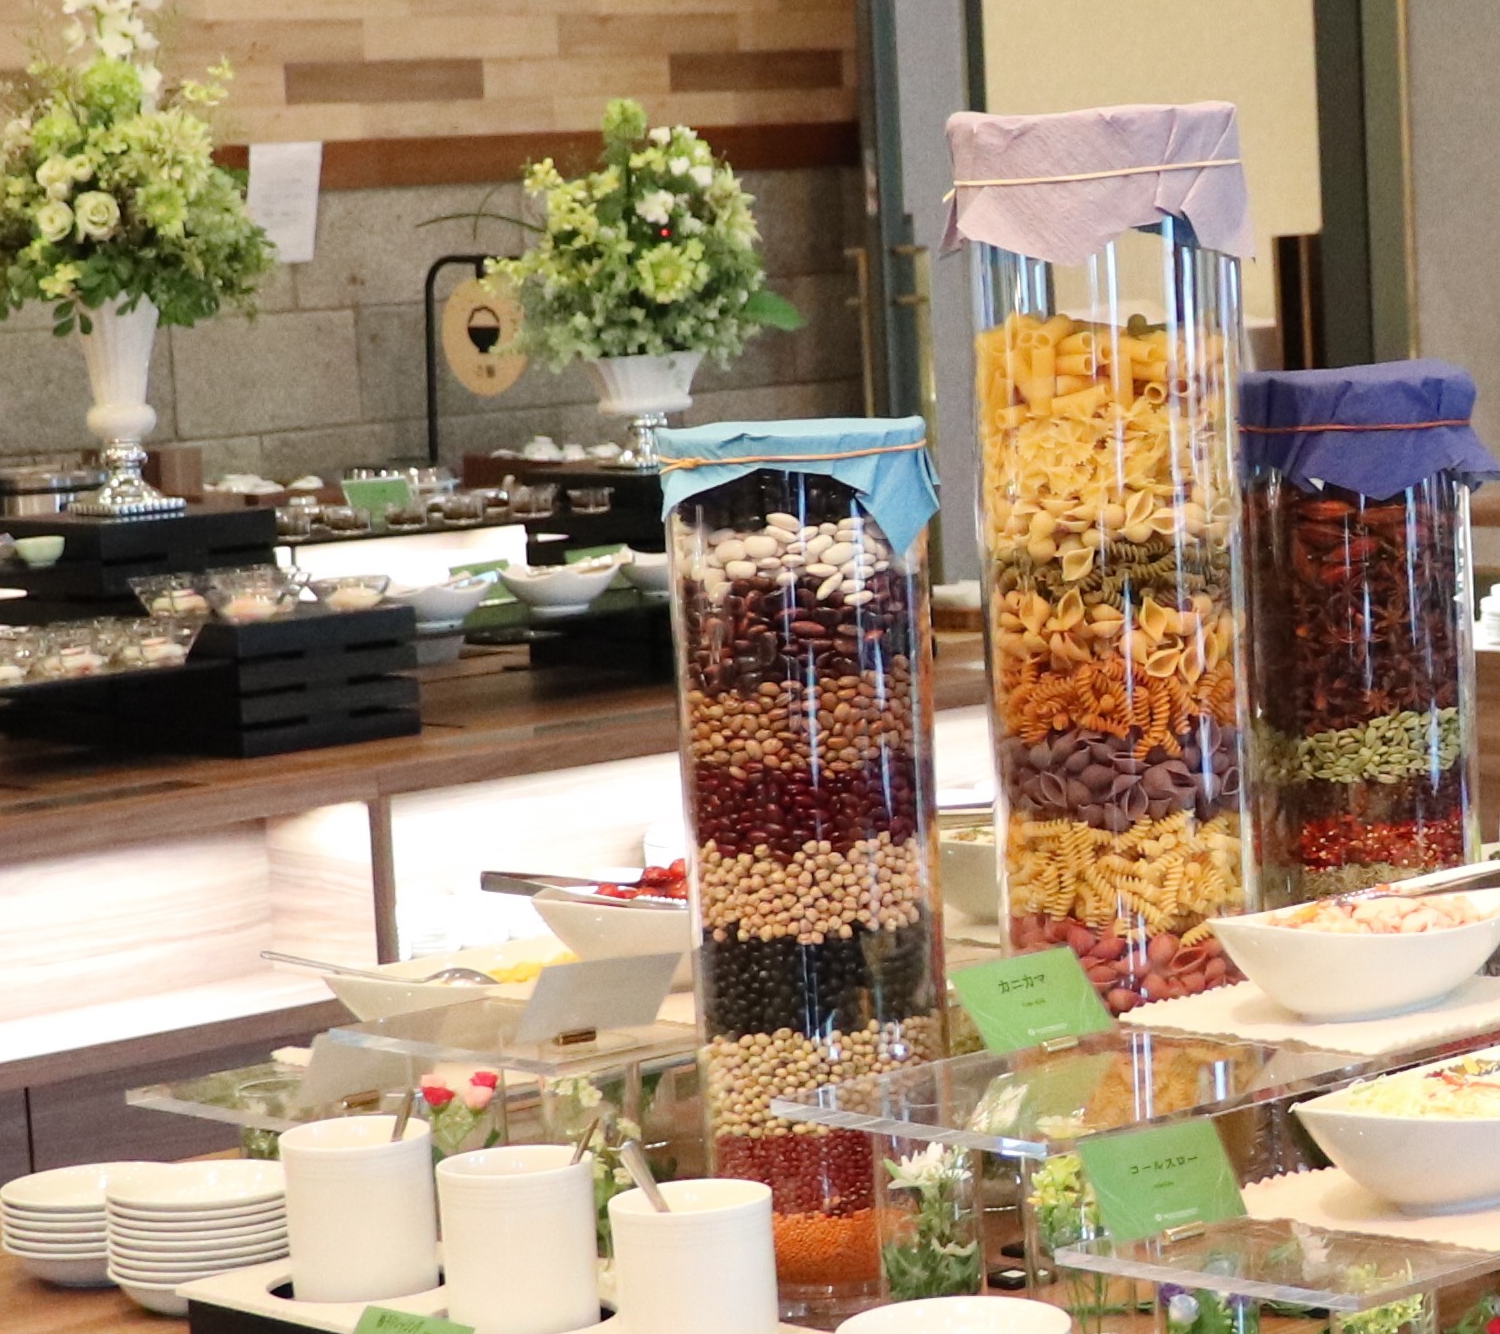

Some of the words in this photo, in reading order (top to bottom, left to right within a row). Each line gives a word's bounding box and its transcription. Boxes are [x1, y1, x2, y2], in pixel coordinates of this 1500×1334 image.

[998, 973, 1045, 995] カニカマ
[1130, 1156, 1199, 1175] コールスロー
